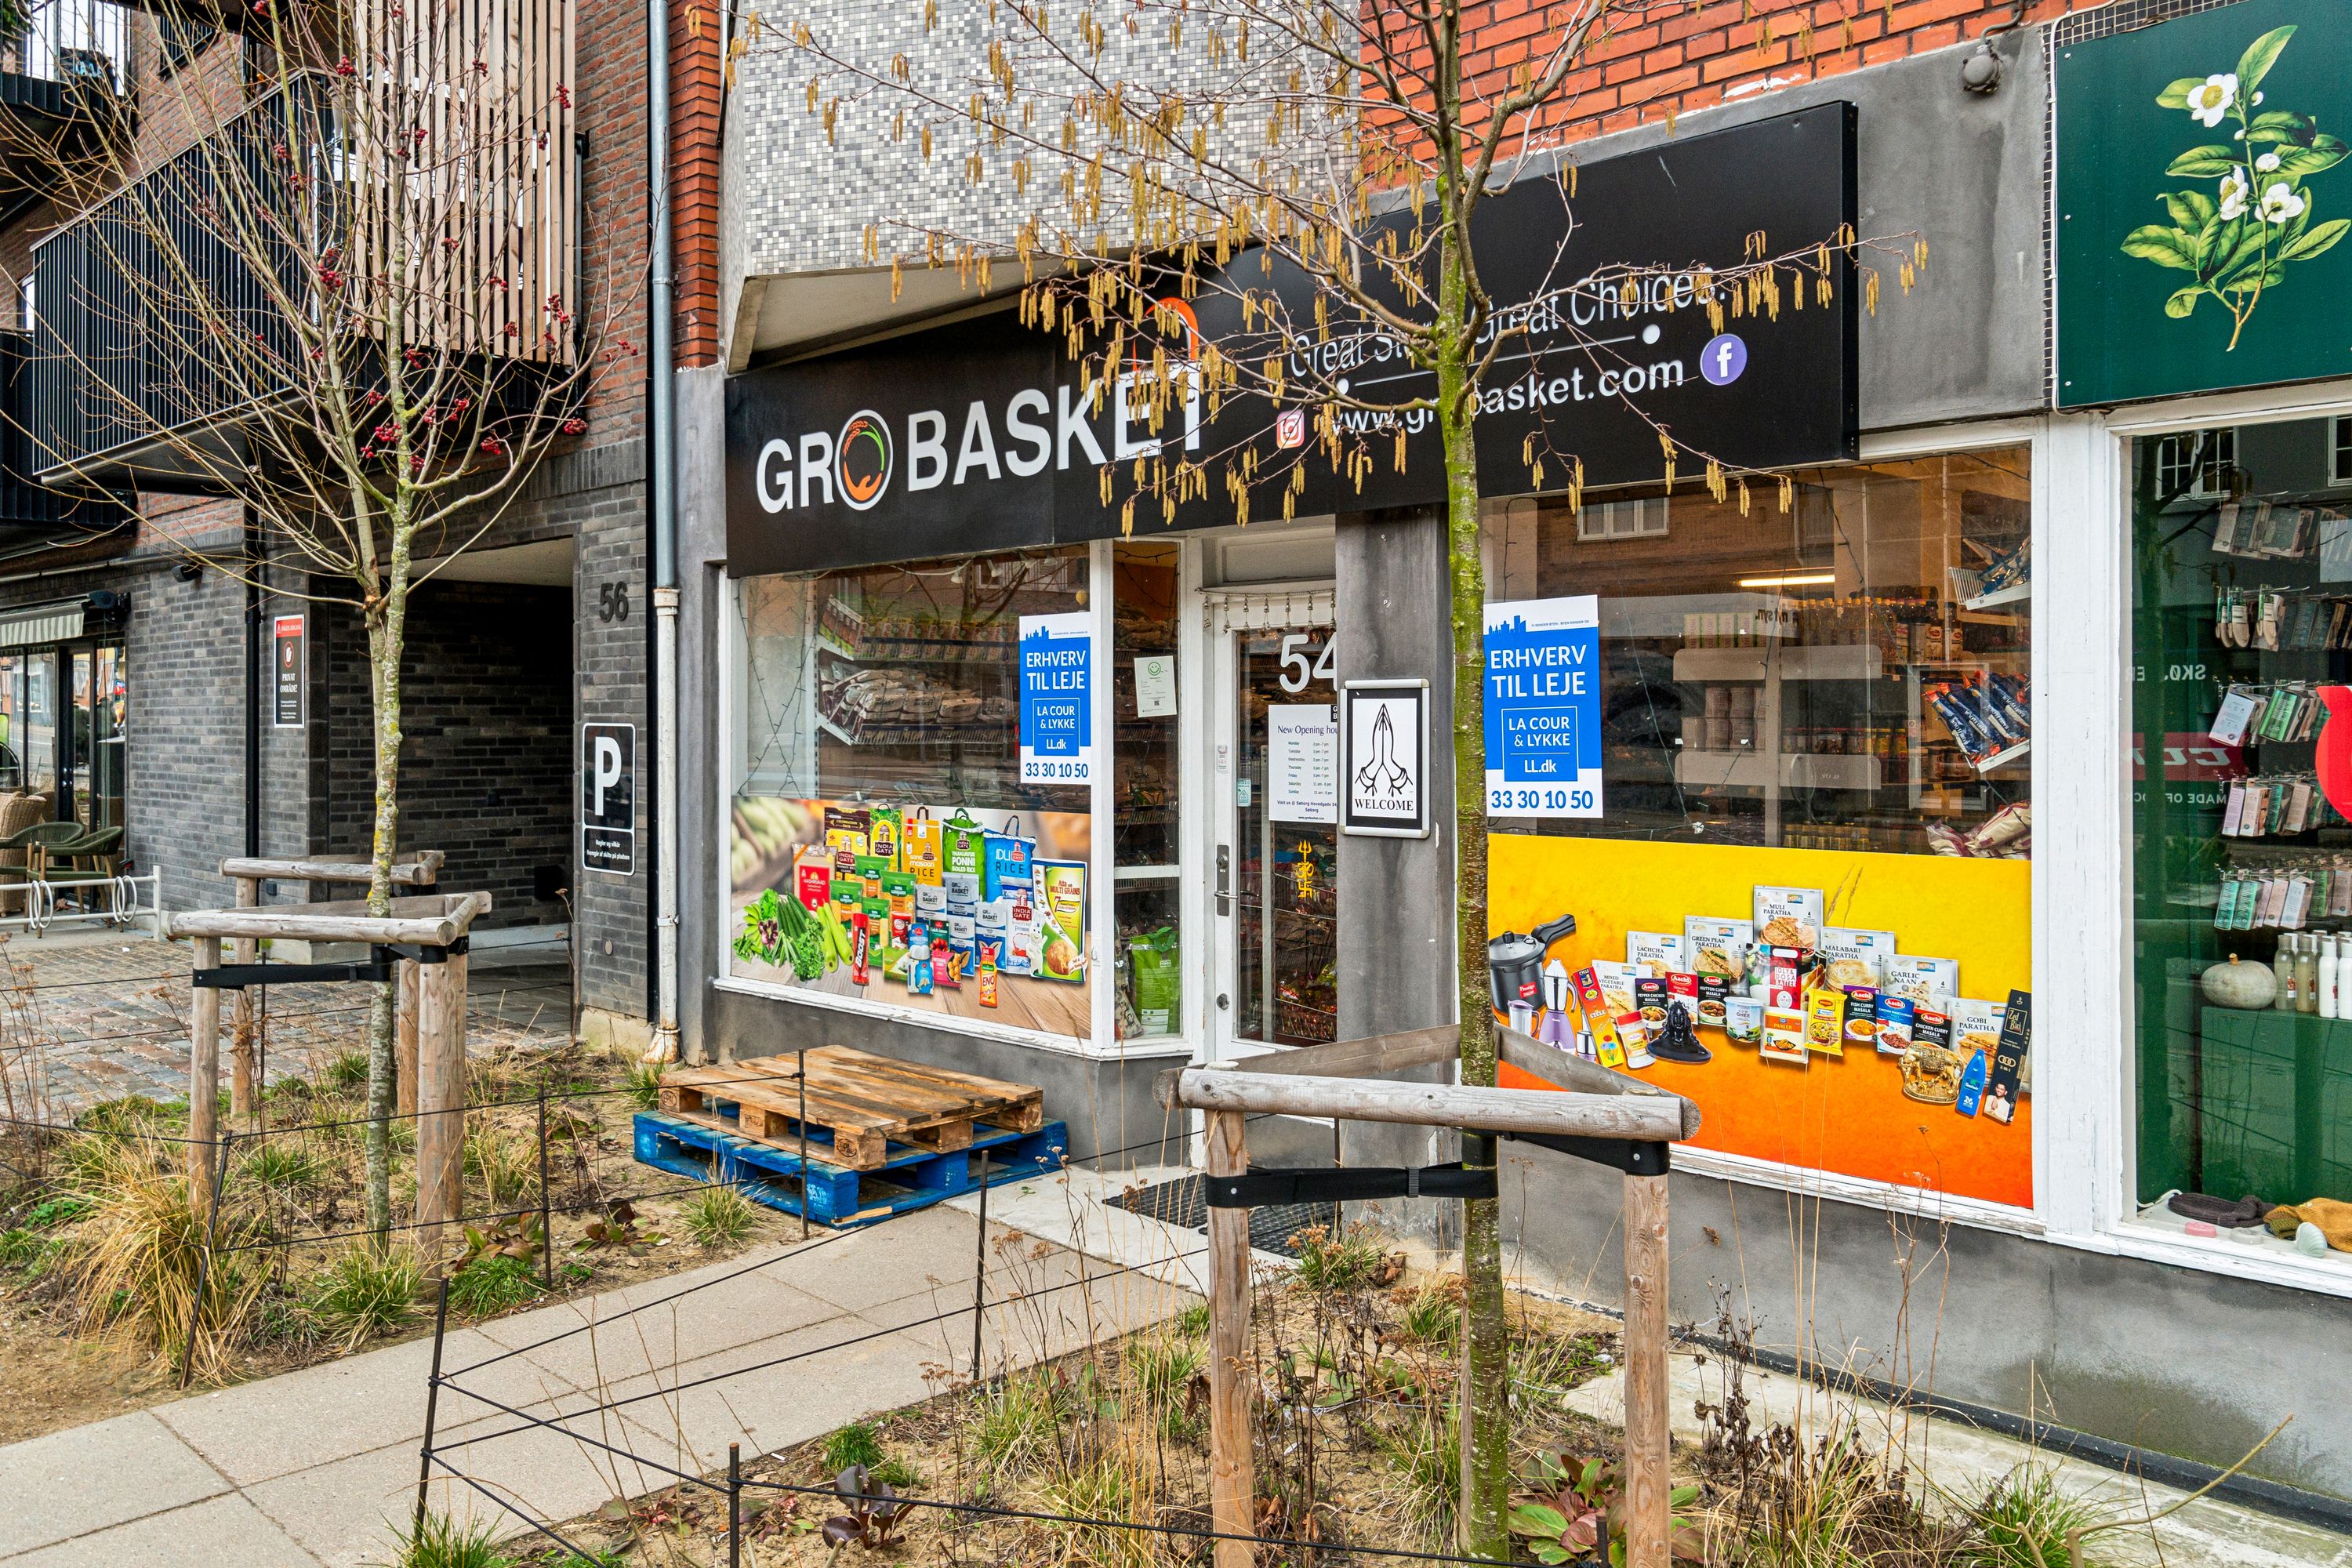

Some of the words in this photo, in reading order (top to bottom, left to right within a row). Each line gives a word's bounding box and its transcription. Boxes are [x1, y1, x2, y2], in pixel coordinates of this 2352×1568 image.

[1291, 327, 1363, 377] Great
[757, 409, 894, 514] GRO
[599, 581, 629, 622] 56
[1026, 650, 1086, 668] ERHVERV
[1279, 631, 1338, 693] 54
[1490, 644, 1587, 670] ERHVERV
[1027, 672, 1050, 691] TIL
[1052, 670, 1086, 690] LEJE
[1491, 674, 1527, 698] TIL
[1534, 671, 1586, 697] LEJE
[1037, 706, 1048, 717] LA
[1050, 706, 1075, 717] COUR
[1040, 719, 1047, 729] &
[1048, 718, 1075, 729] LYKKE
[1508, 717, 1526, 731] LA
[1530, 717, 1570, 731] COUR
[1277, 725, 1293, 734] New
[1294, 725, 1324, 736] Opening
[1047, 739, 1067, 750] LL.dk
[1514, 734, 1523, 747] &
[1527, 733, 1570, 747] LYKKE
[1025, 763, 1040, 777] 33
[1041, 763, 1055, 778] 30
[1058, 763, 1073, 778] 10
[1074, 763, 1088, 779] 50
[1524, 759, 1557, 773] LL.dk
[595, 736, 622, 815] P
[1355, 798, 1414, 811] WELCOME
[1491, 790, 1513, 809] 33
[1517, 790, 1540, 809] 30
[1545, 790, 1566, 809] 10
[1570, 790, 1593, 810] 50
[952, 857, 976, 866] PONNI
[996, 862, 1024, 874] RICE
[1064, 887, 1080, 895] GRAINS
[1054, 896, 1062, 913] 7
[855, 928, 866, 969] BOOST
[1824, 945, 1861, 953] MALABARI
[1827, 951, 1859, 960] PARATHA
[982, 975, 995, 986] ENO
[1891, 971, 1920, 979] GARLIC
[1590, 1009, 1606, 1019] CYCLE
[2009, 1009, 2020, 1021] Zed
[1958, 1022, 1995, 1032] PARATHA
[2010, 1019, 2022, 1030] Black
